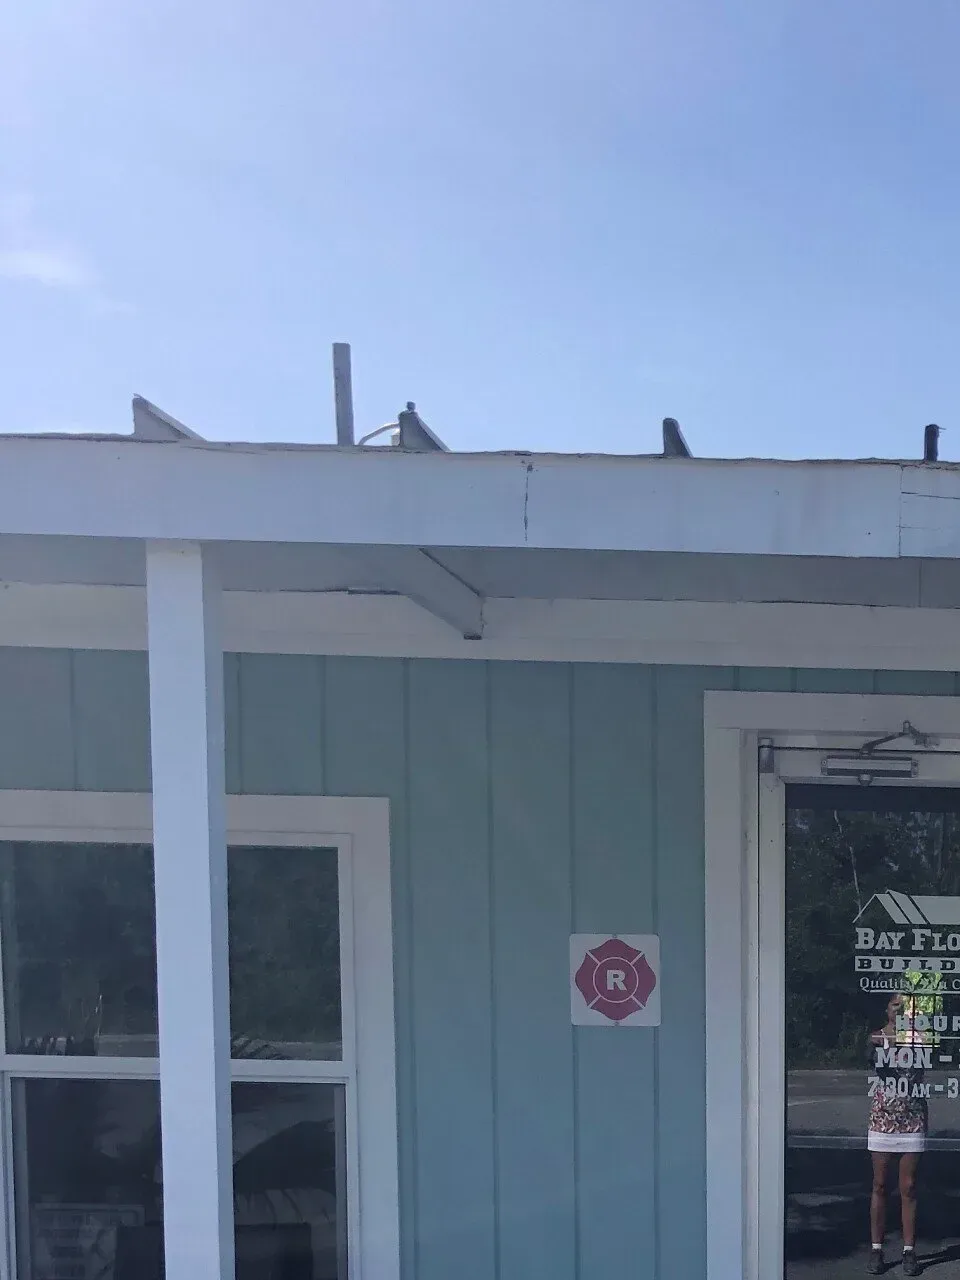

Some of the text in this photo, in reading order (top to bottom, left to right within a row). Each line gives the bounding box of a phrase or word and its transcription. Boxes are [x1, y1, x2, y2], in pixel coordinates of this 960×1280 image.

[855, 927, 906, 951] BAY
[606, 969, 628, 991] R
[875, 1047, 933, 1069] MON
[911, 1083, 931, 1098] AM
